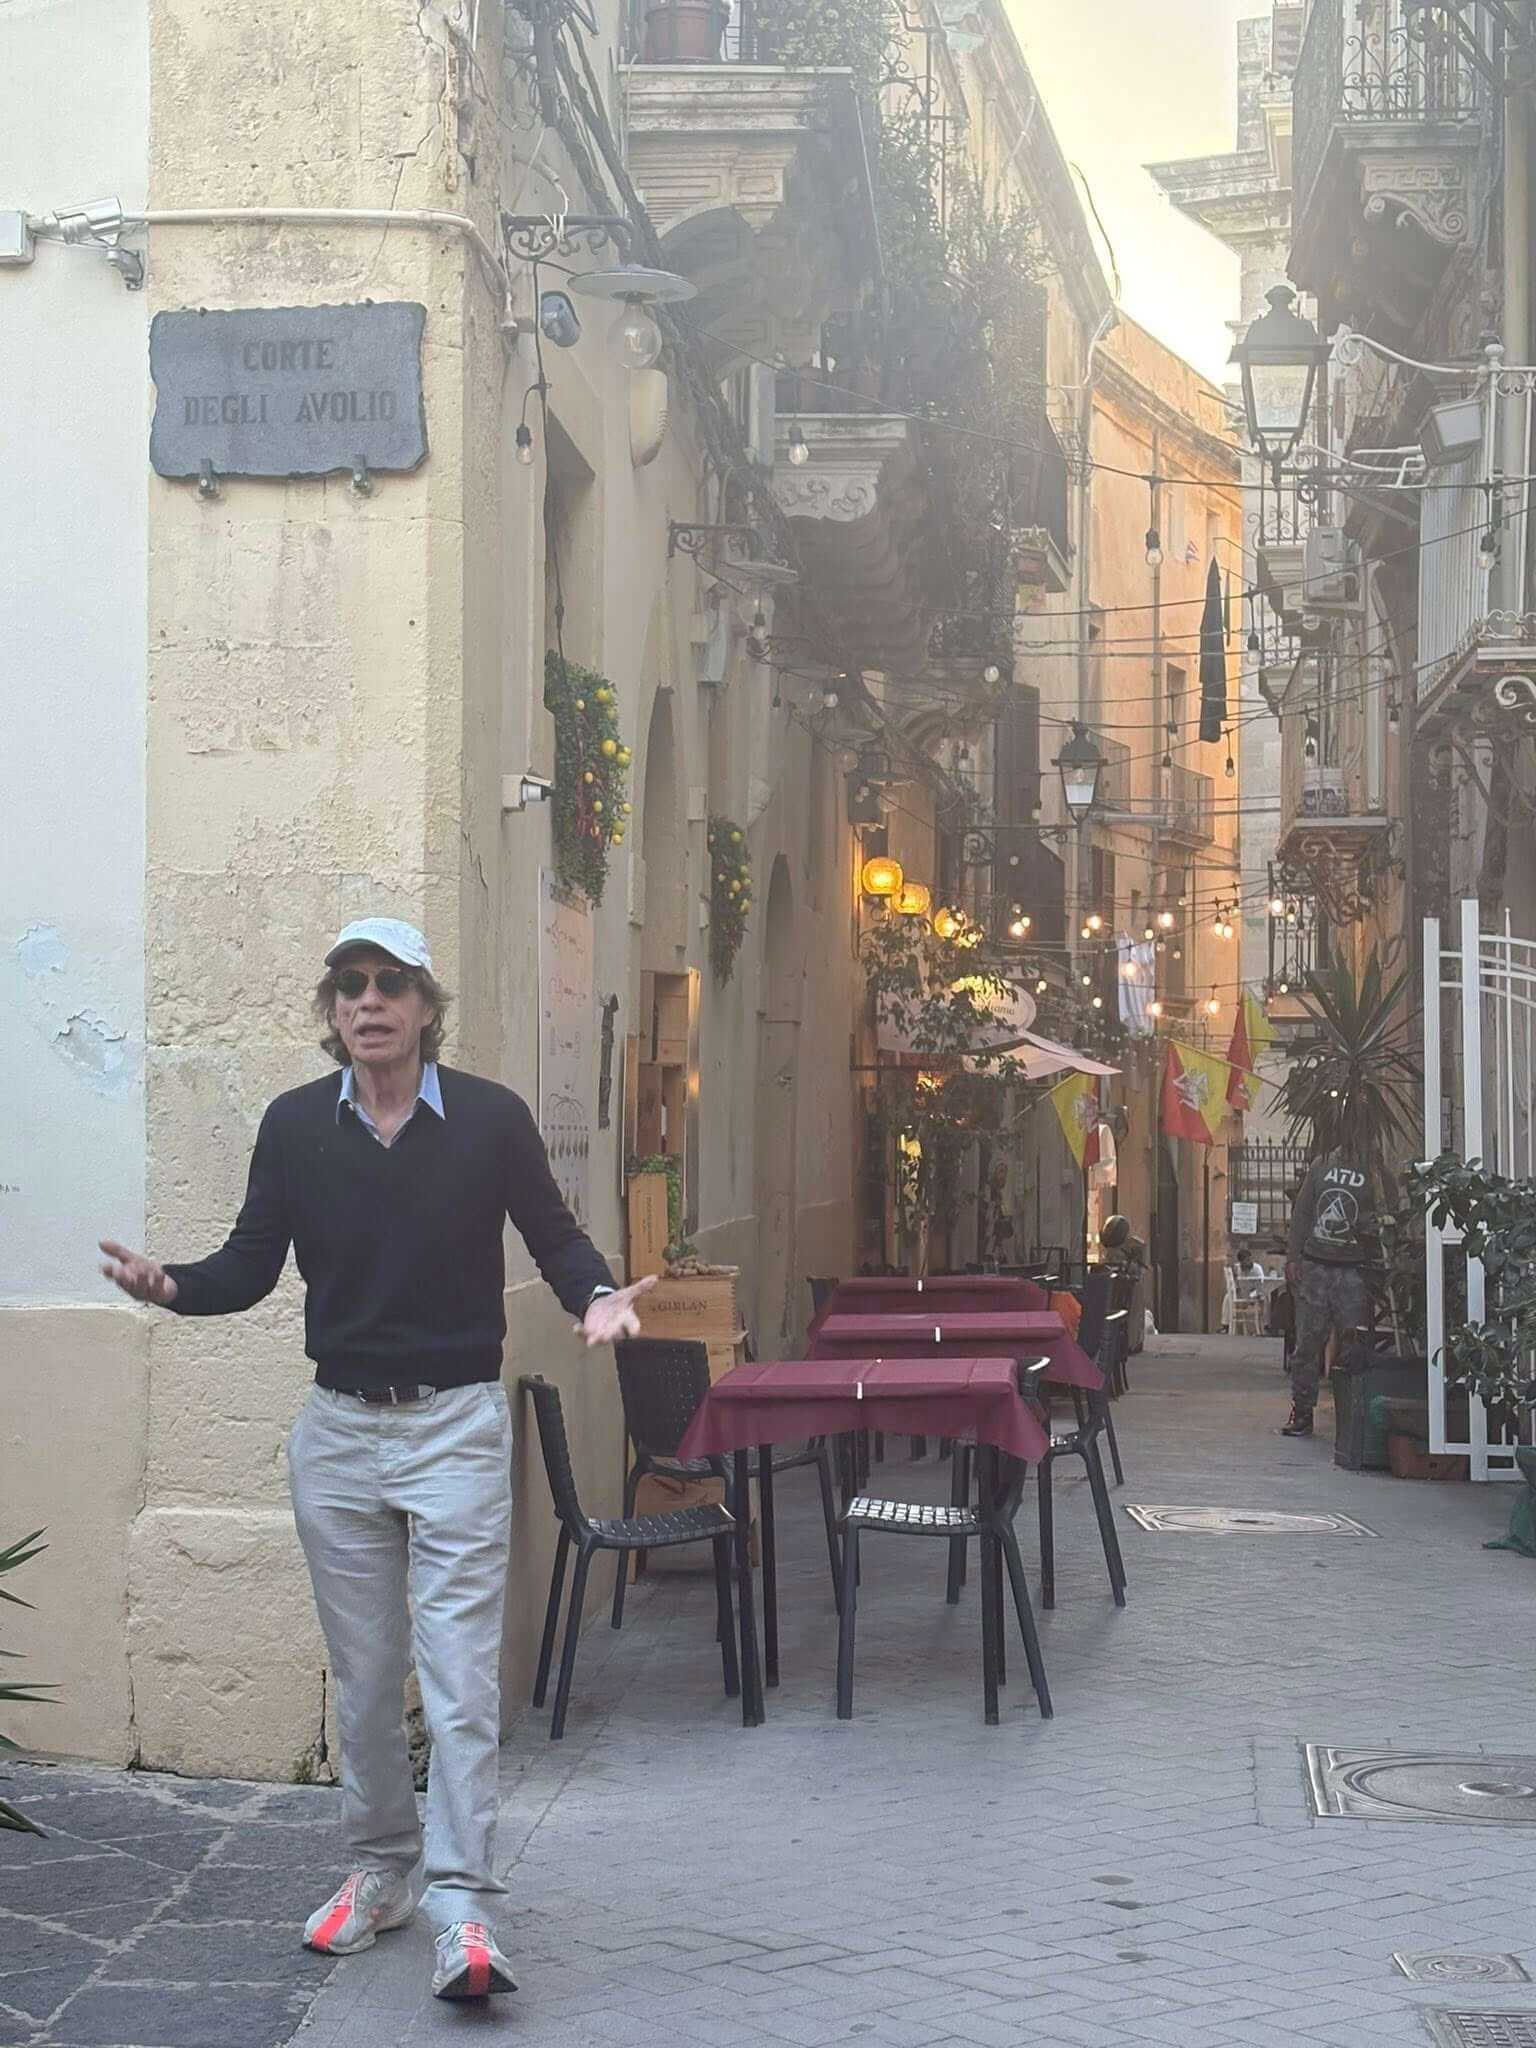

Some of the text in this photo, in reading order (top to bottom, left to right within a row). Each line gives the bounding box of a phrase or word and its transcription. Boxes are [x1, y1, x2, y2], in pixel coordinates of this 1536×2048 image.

[243, 340, 334, 370] CORTE
[183, 390, 398, 426] DEGLI AVOLIO
[1324, 1167, 1365, 1187] ATD
